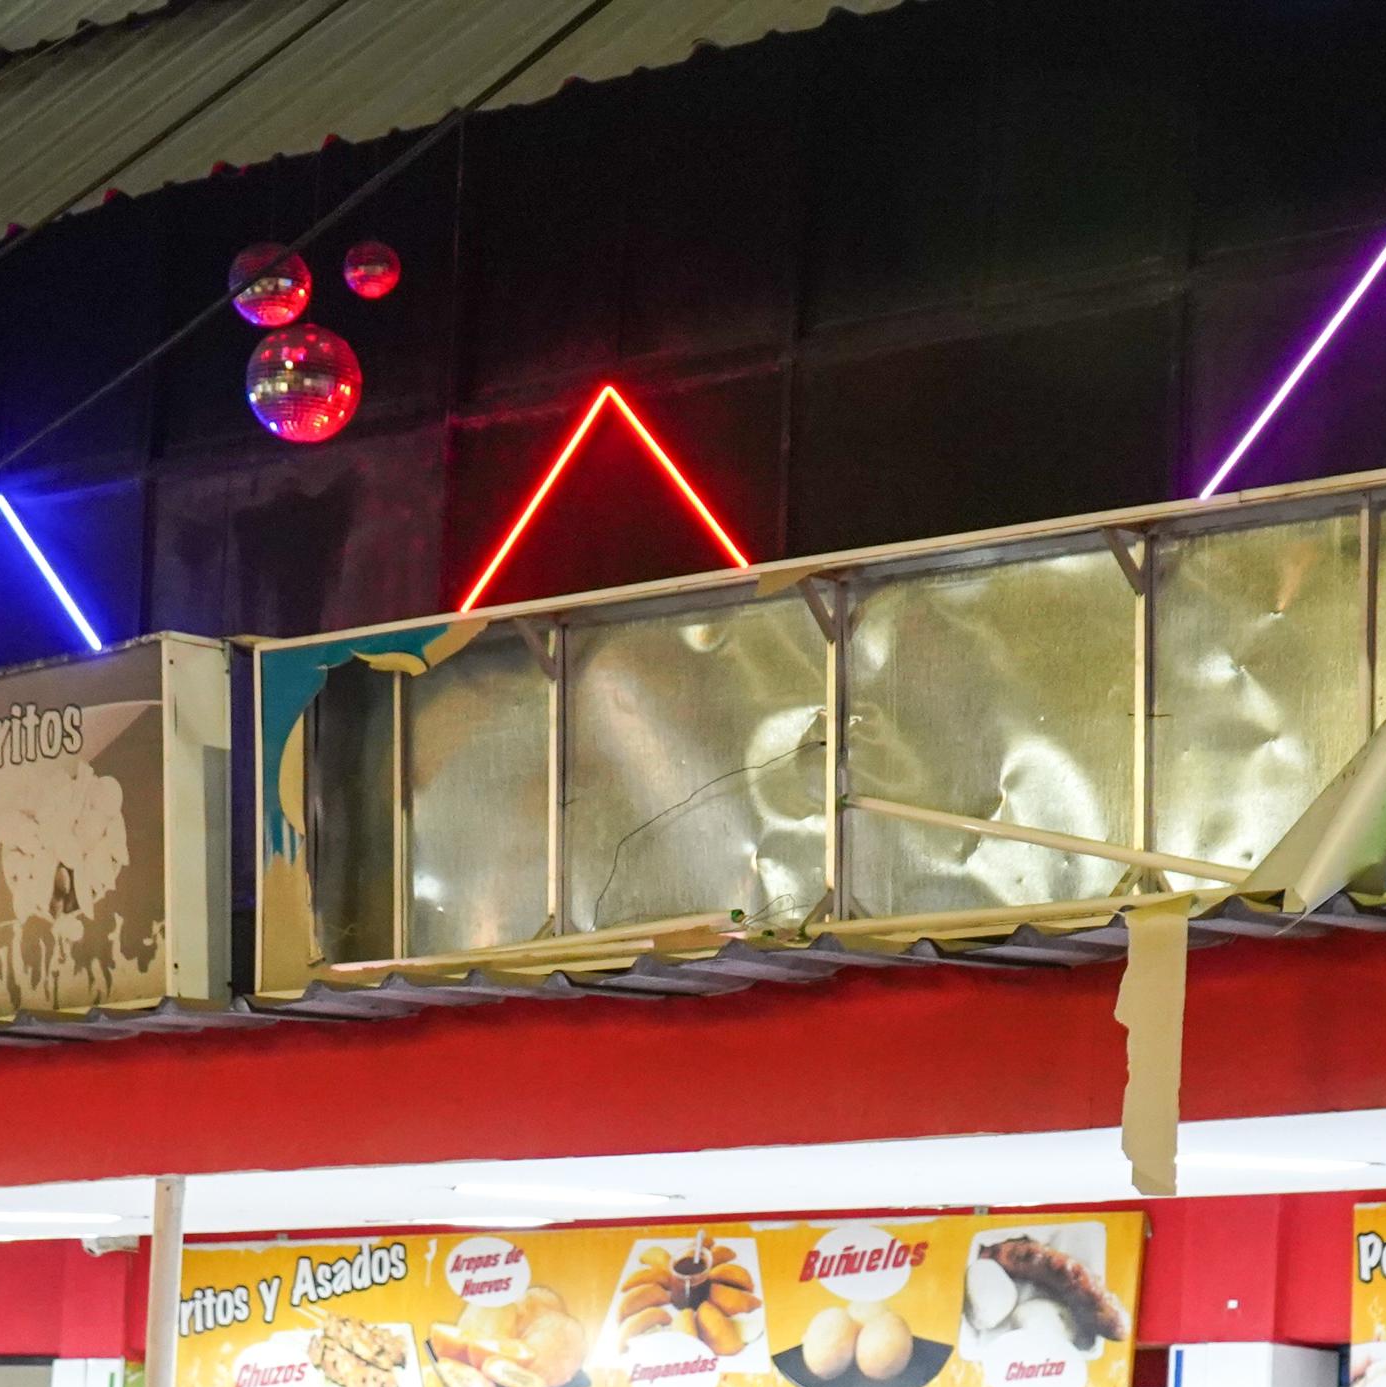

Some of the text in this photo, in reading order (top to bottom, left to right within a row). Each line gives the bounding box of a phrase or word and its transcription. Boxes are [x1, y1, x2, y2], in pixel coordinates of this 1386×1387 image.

[451, 1245, 525, 1274] Arepas de
[798, 1238, 929, 1284] Buñuelos
[179, 1241, 408, 1336] ritos y Asados
[630, 1354, 718, 1385] Empanadas
[1004, 1357, 1066, 1381] Chorizo
